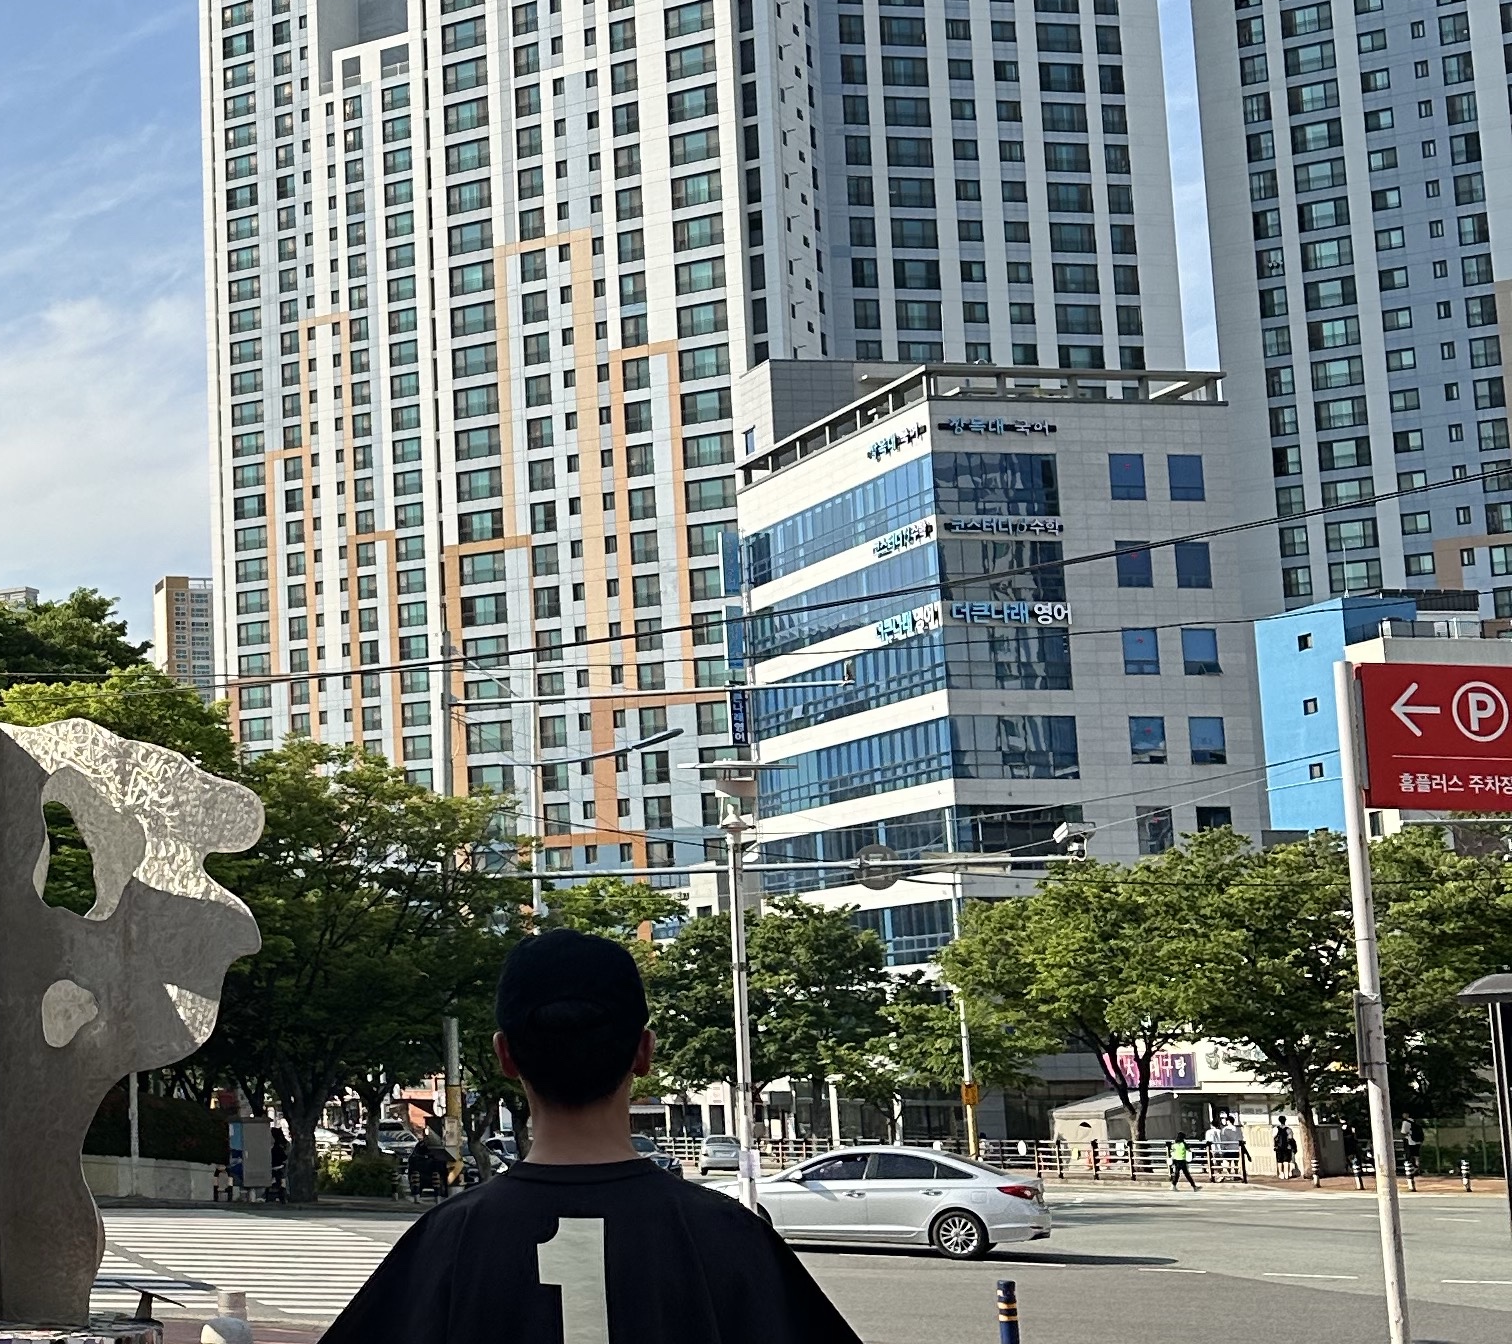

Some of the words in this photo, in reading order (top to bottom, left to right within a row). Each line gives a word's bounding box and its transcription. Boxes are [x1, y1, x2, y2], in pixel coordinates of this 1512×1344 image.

[1015, 419, 1049, 436] 국어
[950, 517, 1013, 535] 코스터디
[1029, 518, 1060, 536] 수학
[952, 602, 1029, 624] 더큰나래
[1033, 602, 1073, 625] 영어
[1468, 692, 1496, 732] P
[1399, 772, 1465, 794] 홈플러스
